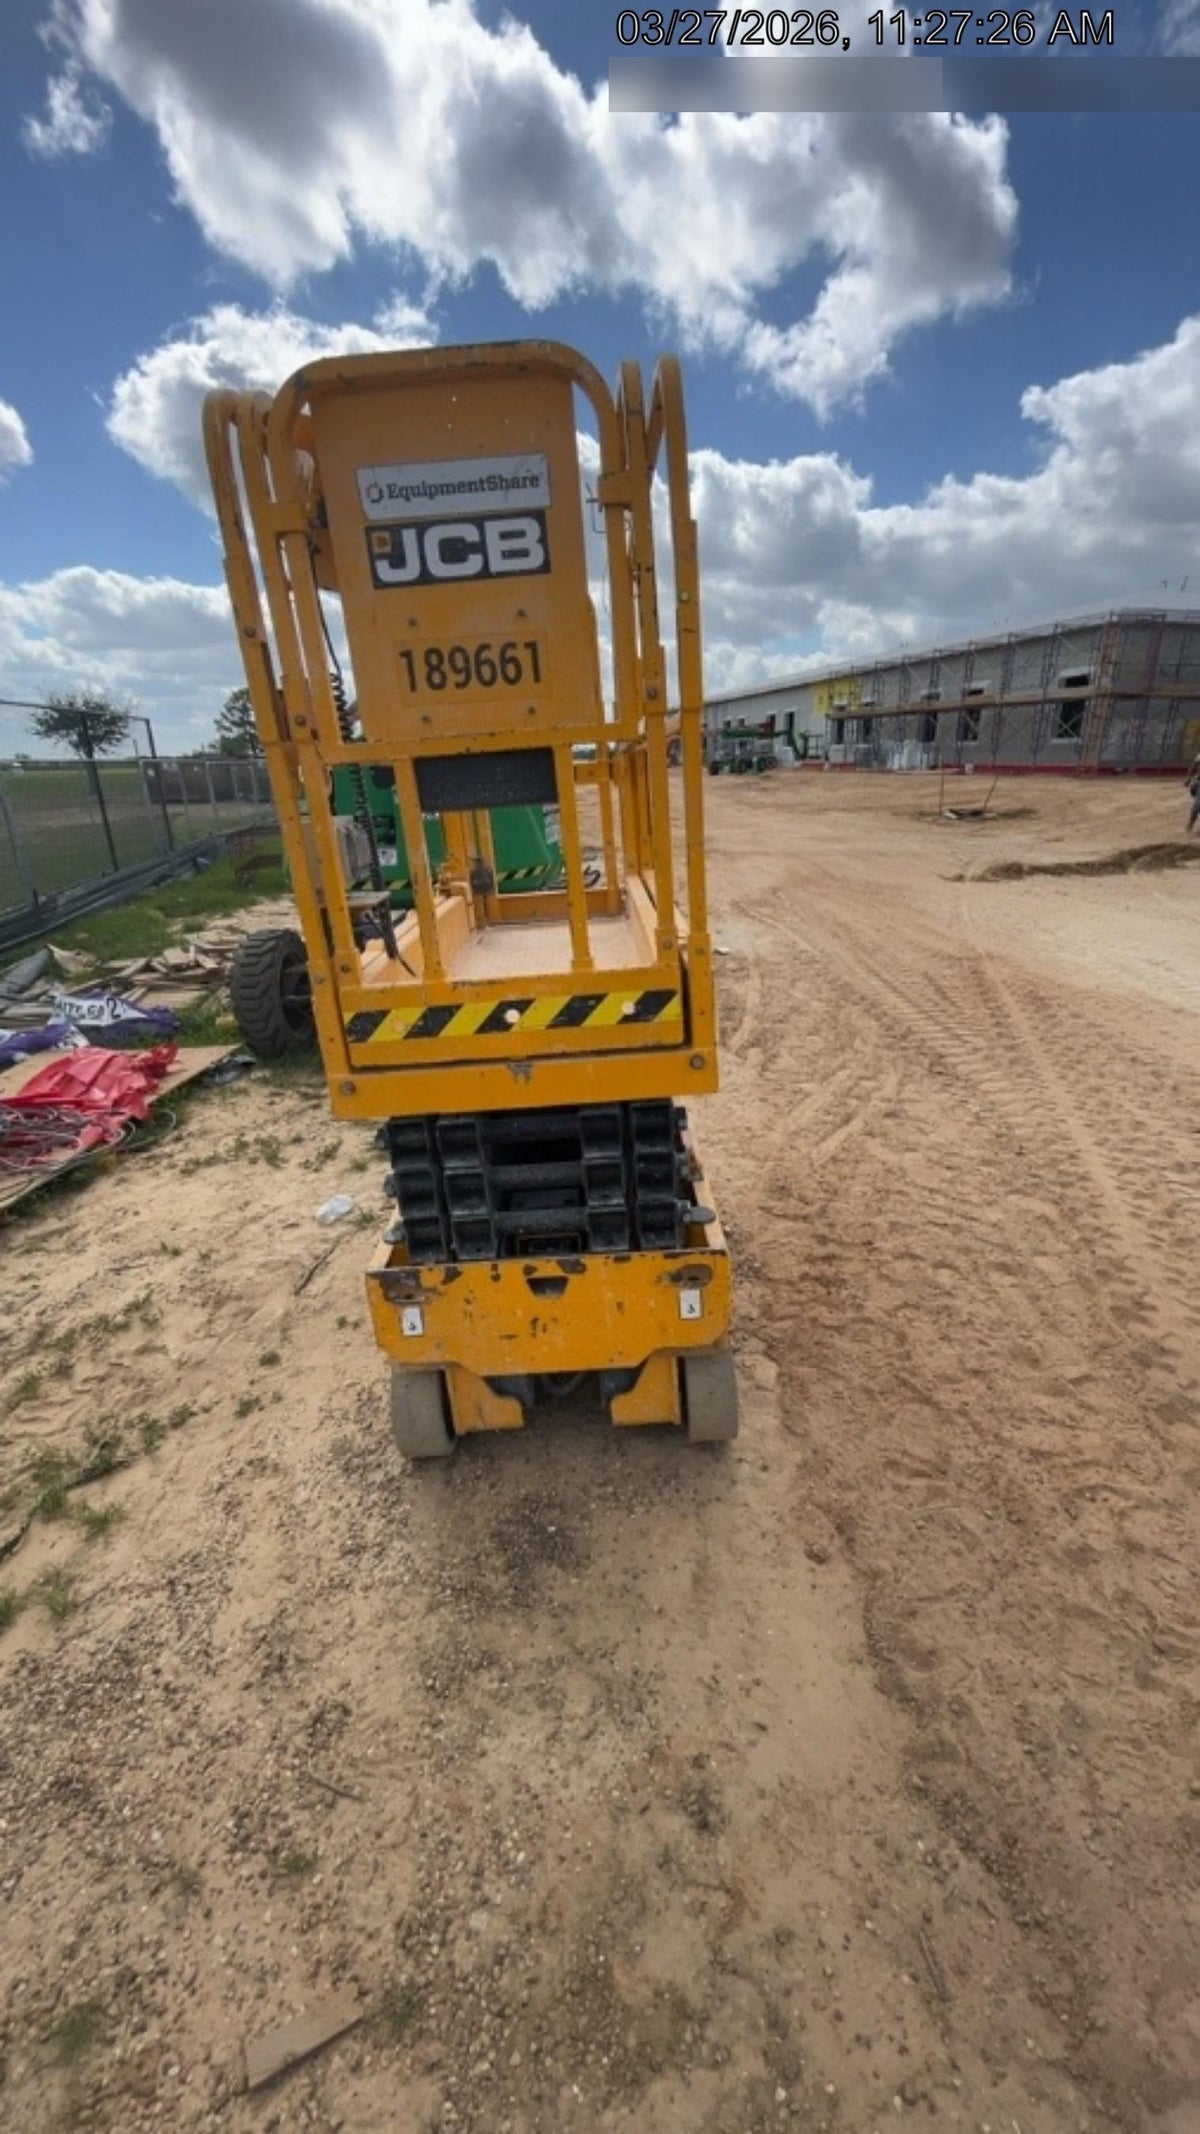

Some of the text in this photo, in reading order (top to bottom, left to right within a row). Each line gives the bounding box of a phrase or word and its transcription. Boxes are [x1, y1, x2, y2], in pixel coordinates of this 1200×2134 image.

[386, 473, 540, 501] EquipmentShare
[375, 517, 545, 583] JCB
[400, 640, 542, 693] 189661
